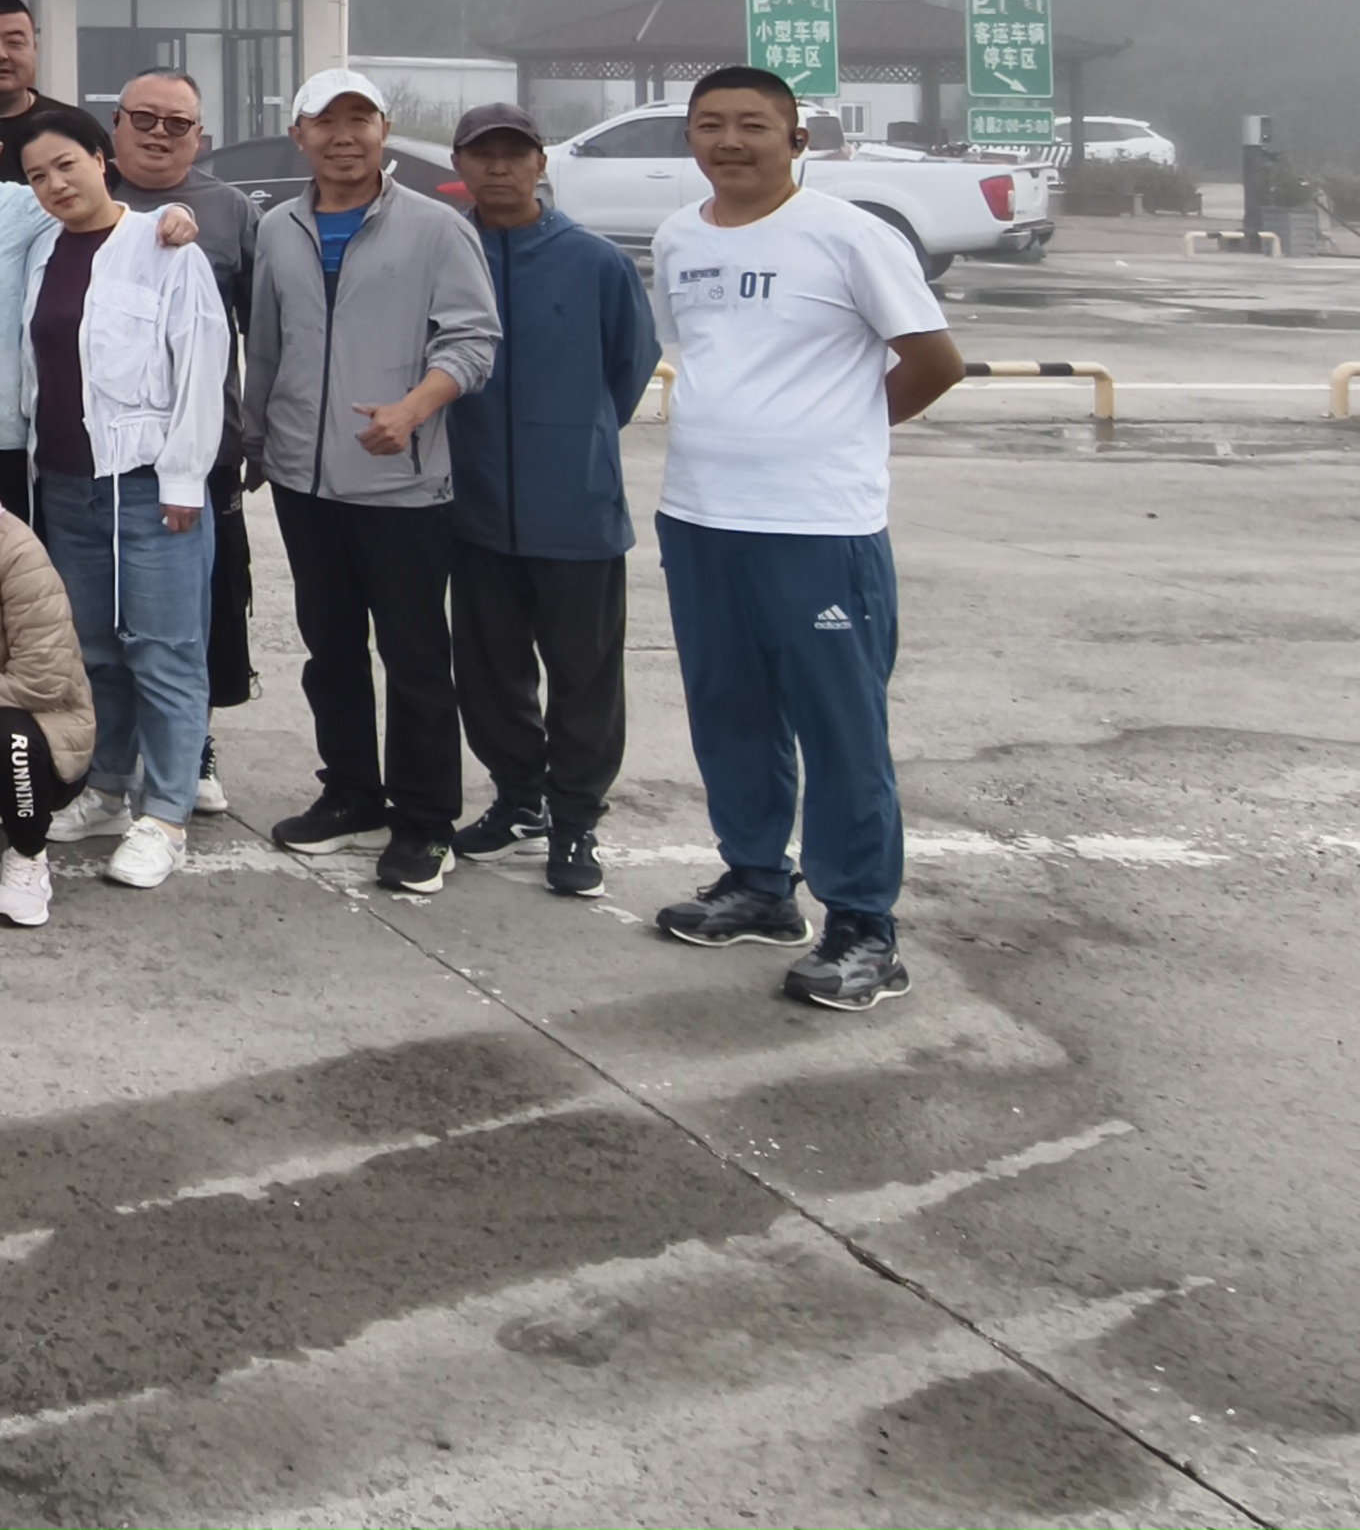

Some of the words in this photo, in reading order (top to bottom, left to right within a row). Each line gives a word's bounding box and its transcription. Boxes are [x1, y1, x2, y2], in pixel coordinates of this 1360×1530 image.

[756, 19, 830, 43] 小型车辆
[974, 21, 1046, 45] 客运车辆
[766, 44, 822, 68] 停车区
[984, 46, 1037, 70] 停车区
[11, 733, 34, 818] RUNNING
